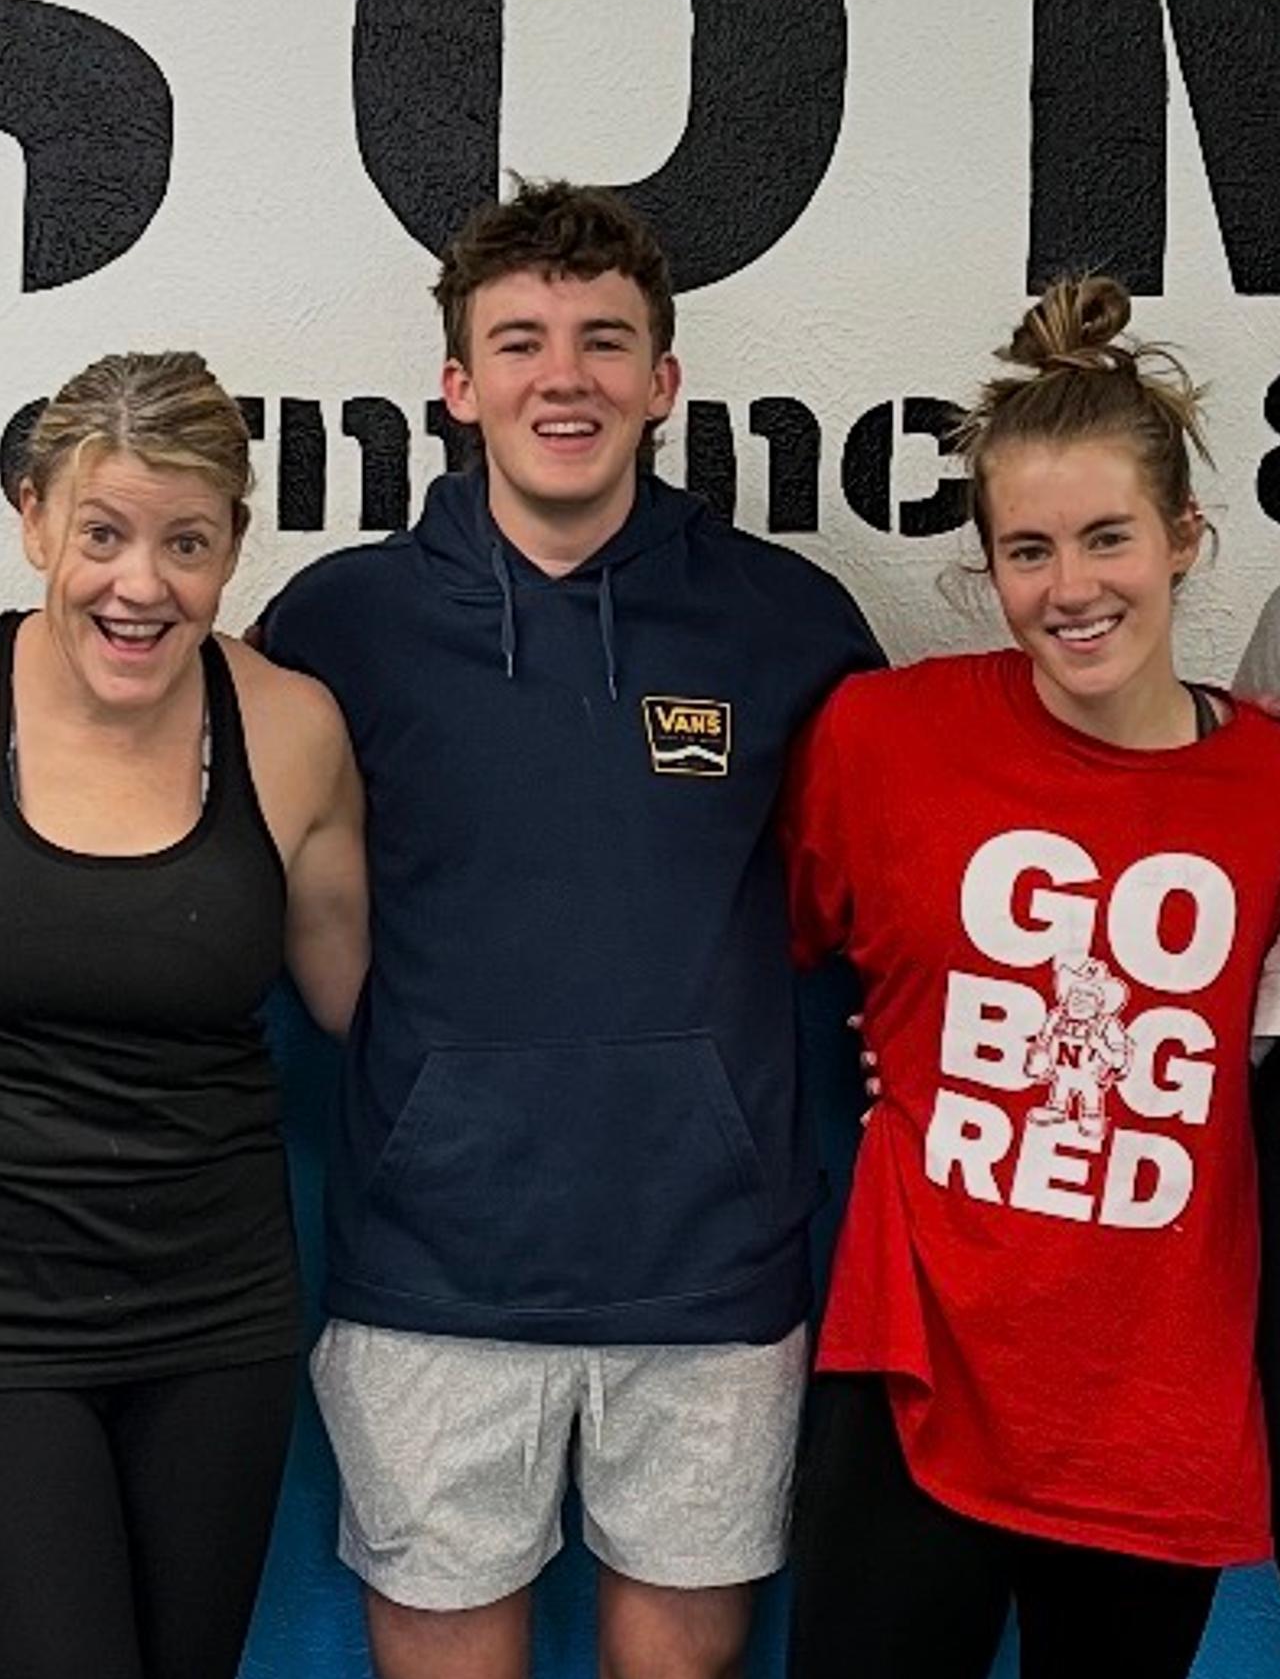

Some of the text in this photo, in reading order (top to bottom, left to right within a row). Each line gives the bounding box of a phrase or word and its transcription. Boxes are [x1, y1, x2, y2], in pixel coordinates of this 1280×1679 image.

[655, 706, 722, 735] VANS
[961, 829, 1237, 994] GO
[940, 969, 1217, 1125] BG
[924, 1087, 1194, 1229] RED
